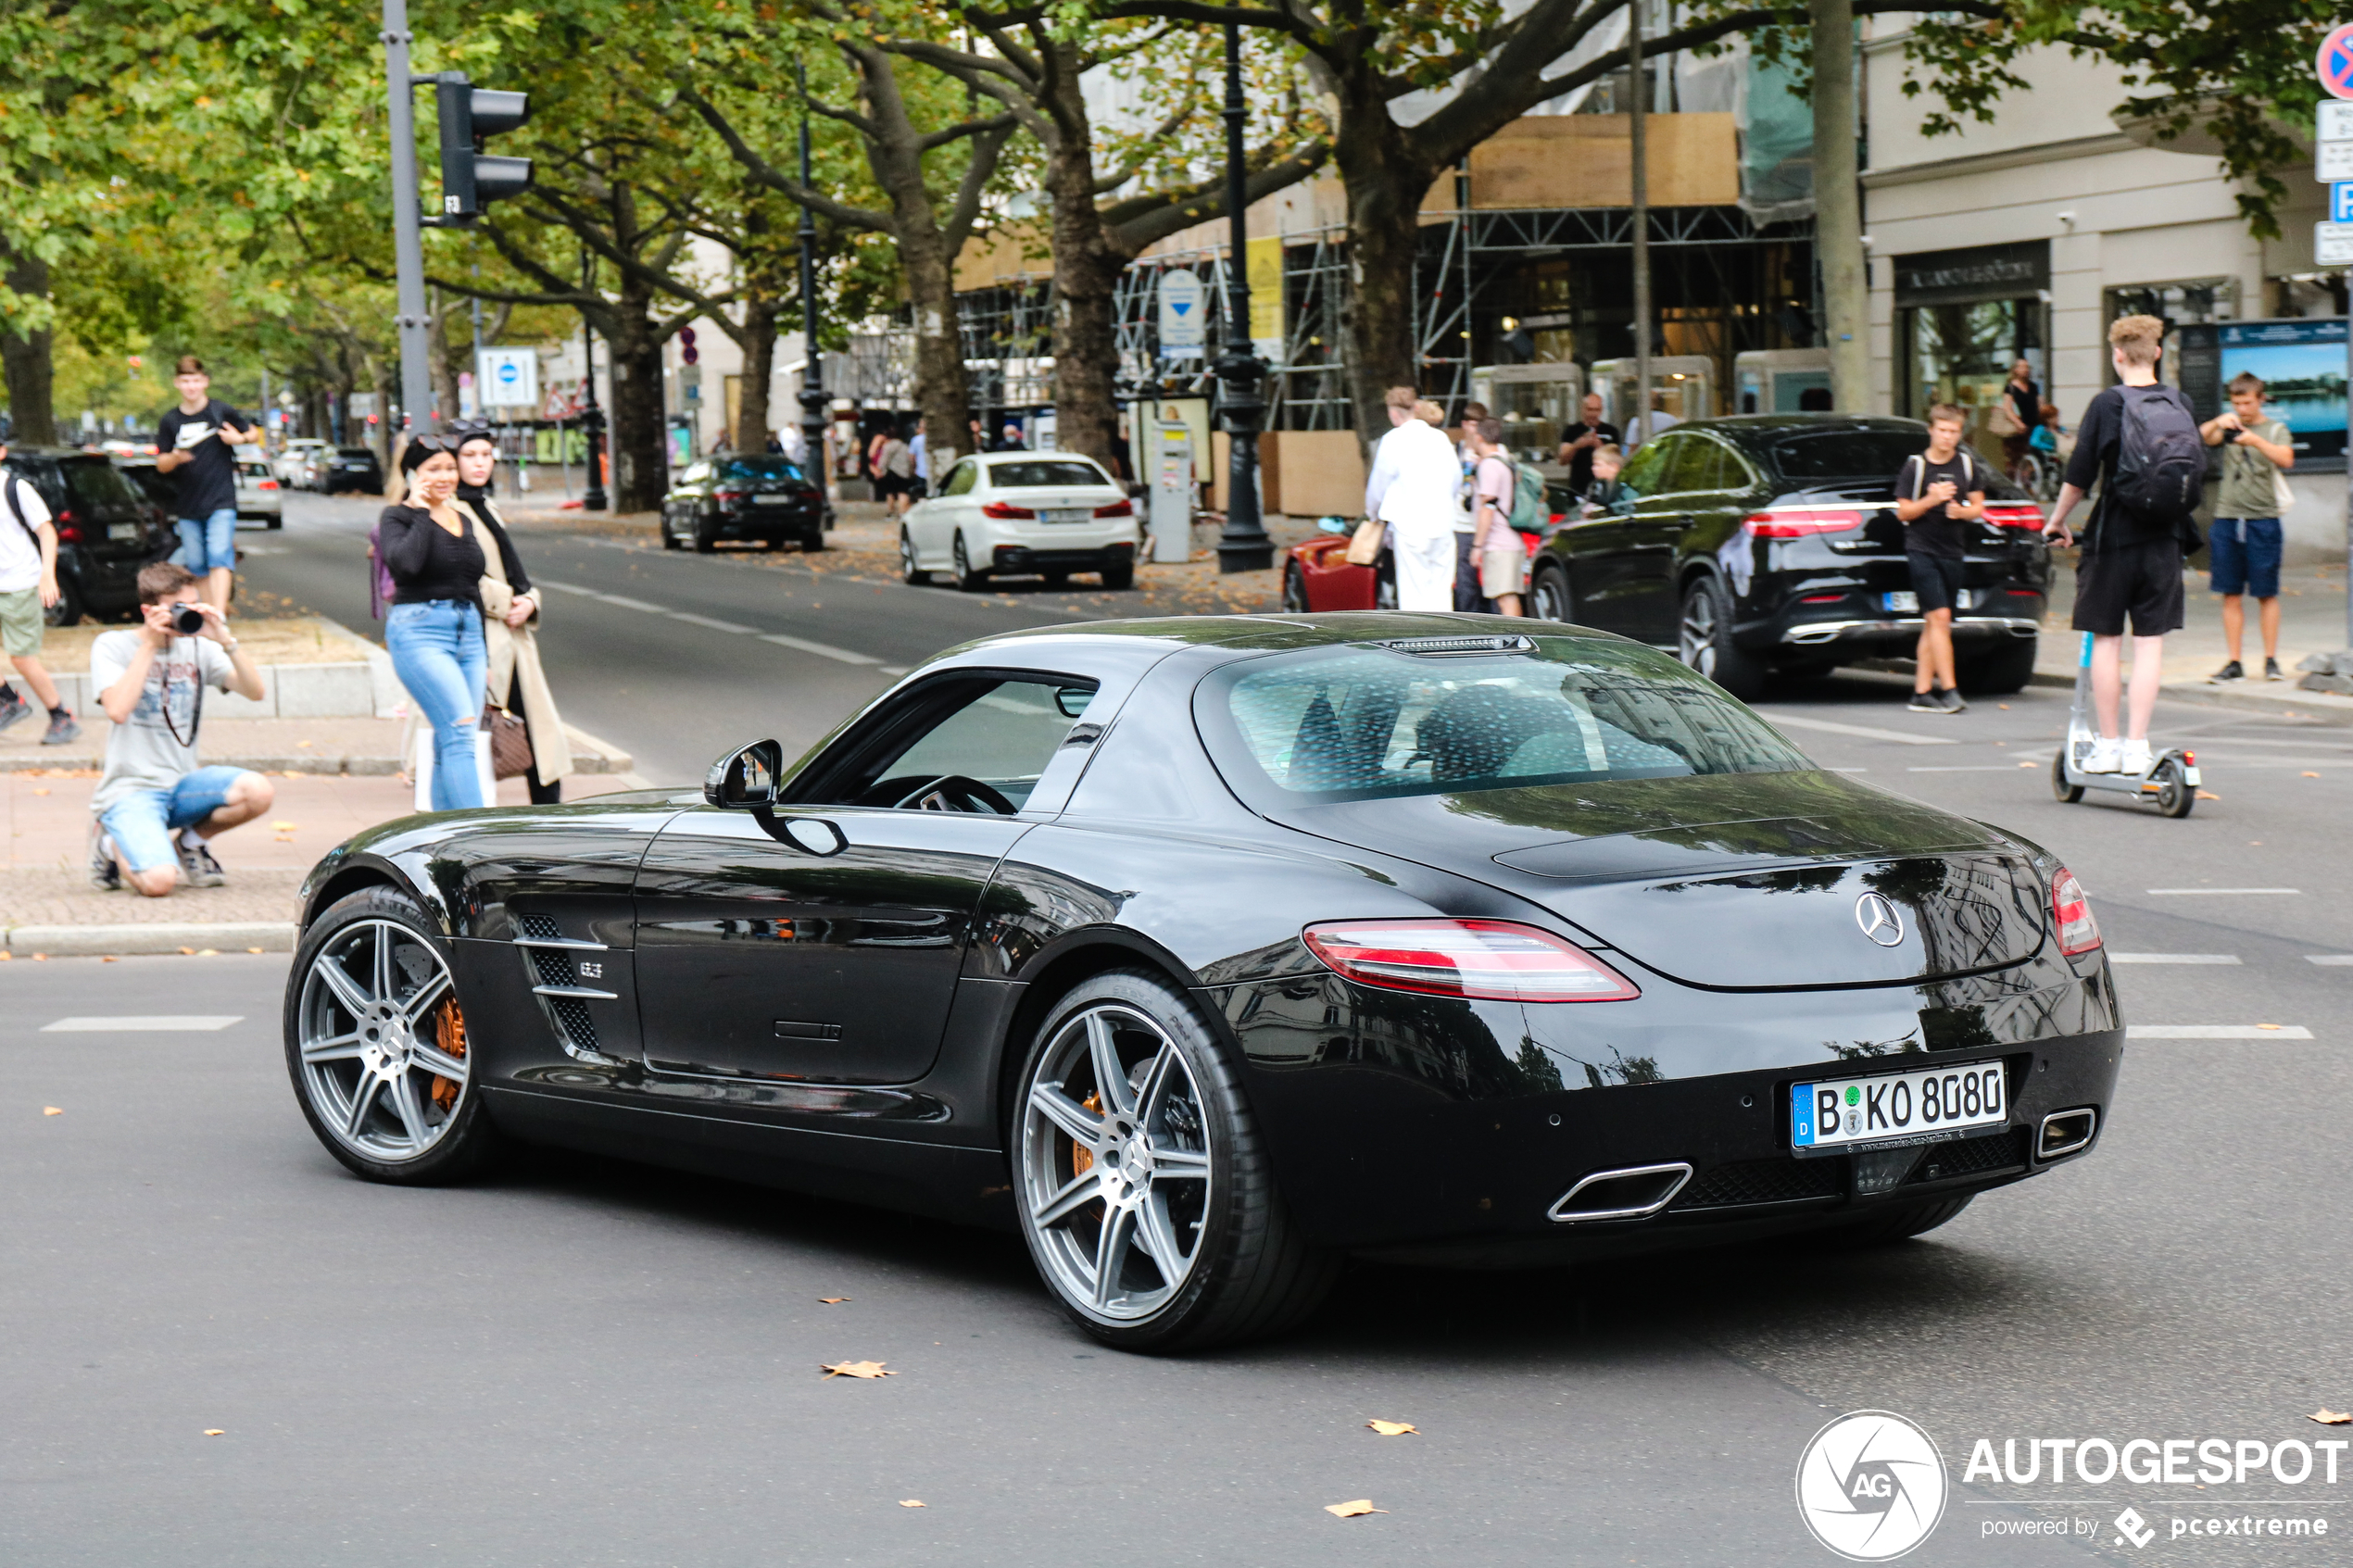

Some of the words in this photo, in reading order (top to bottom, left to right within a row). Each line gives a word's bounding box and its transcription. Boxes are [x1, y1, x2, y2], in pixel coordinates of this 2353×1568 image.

[1818, 1089, 1841, 1135] B
[1867, 1080, 1912, 1130] KO
[1921, 1069, 2001, 1123] 8080
[1800, 1123, 1808, 1135] D
